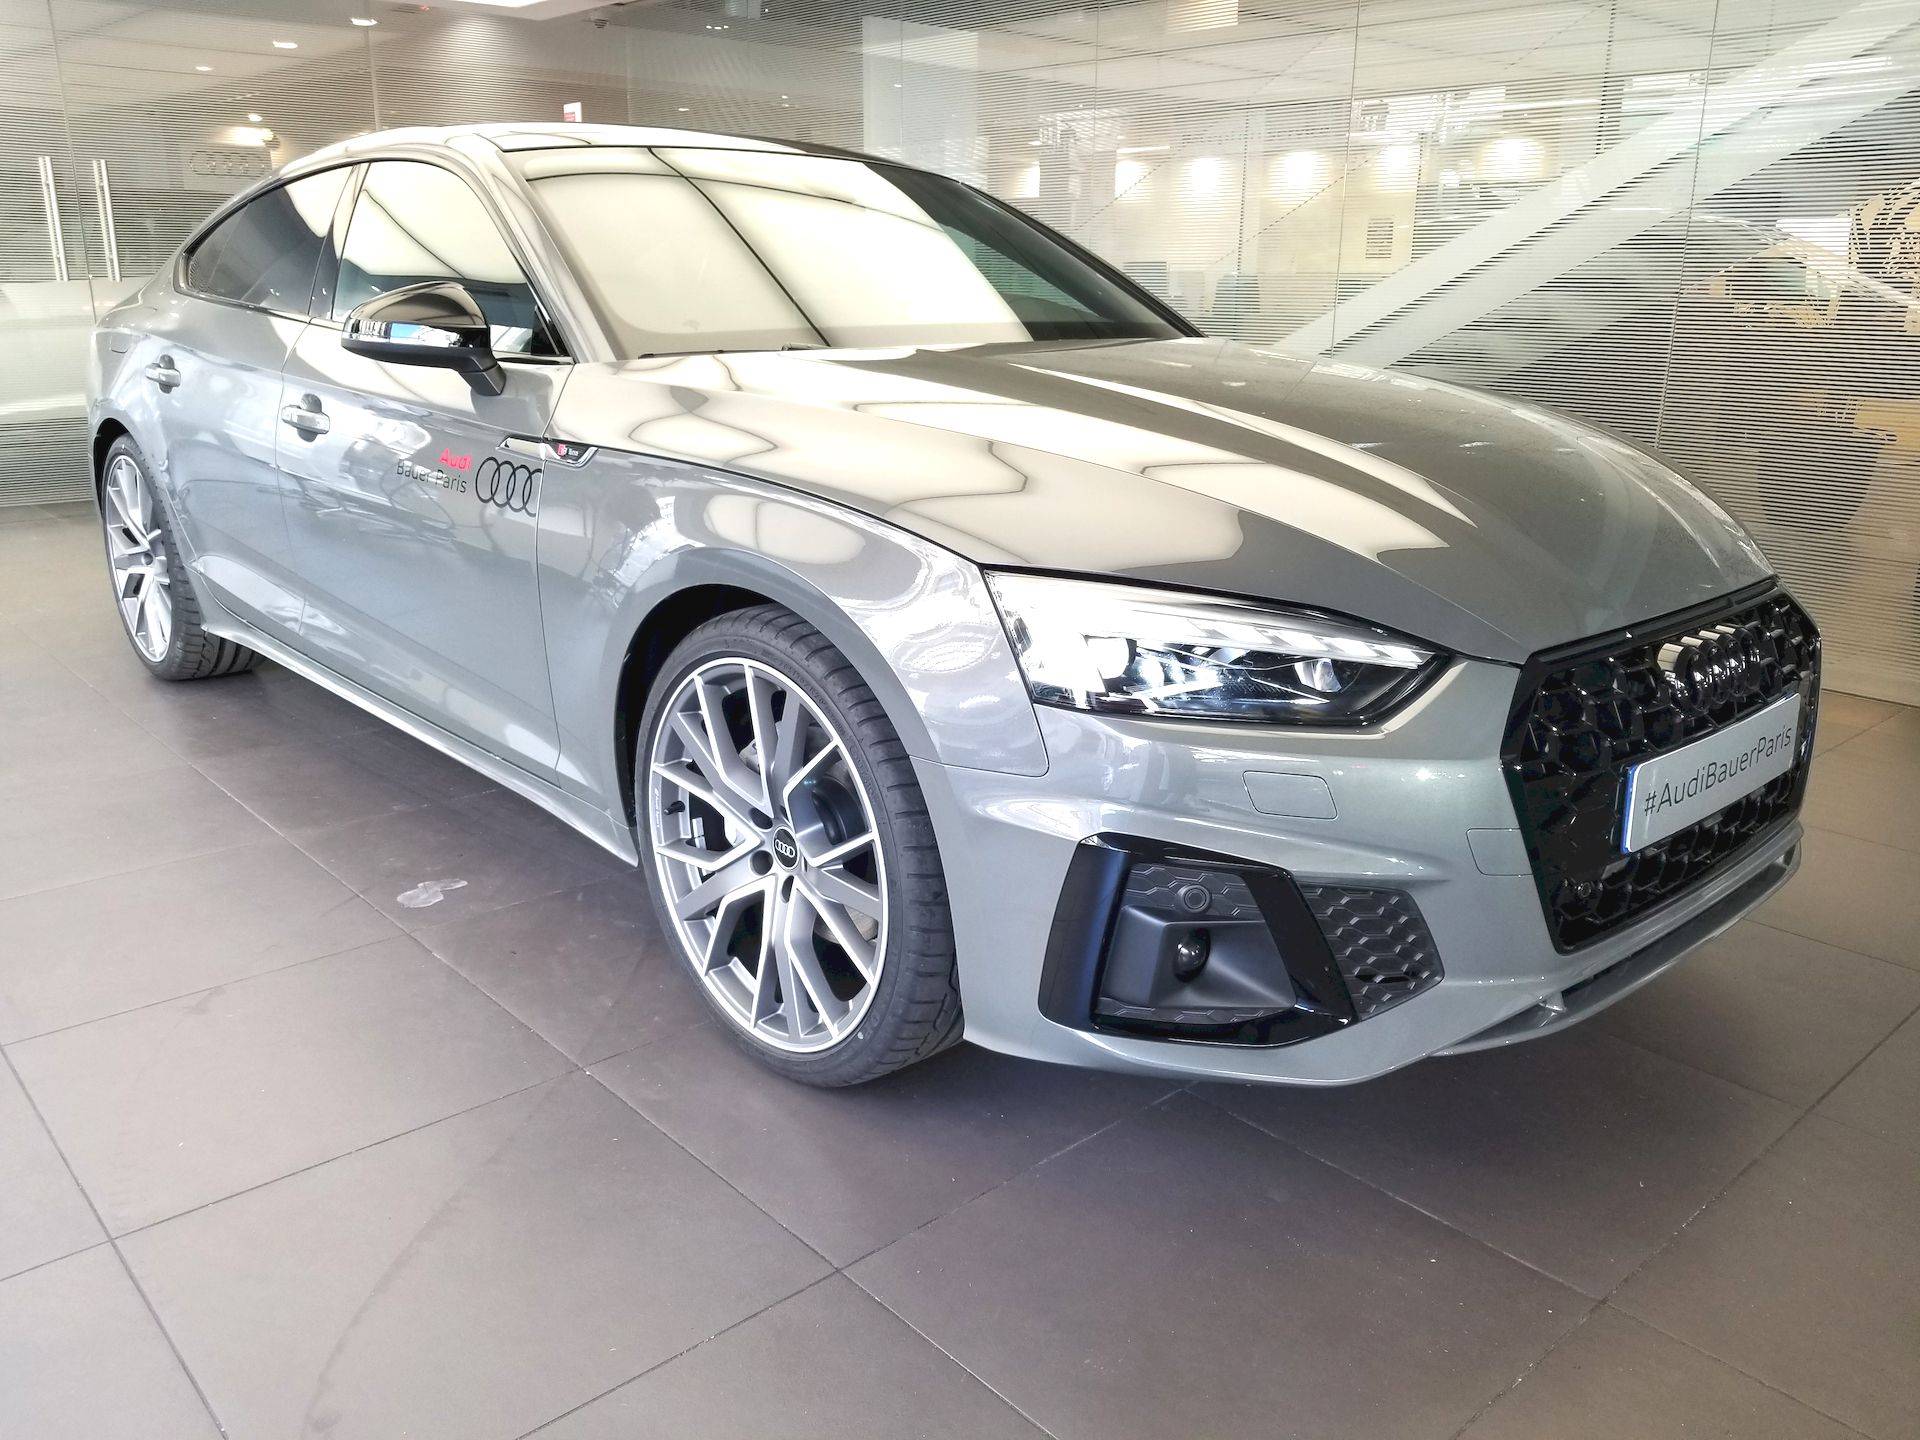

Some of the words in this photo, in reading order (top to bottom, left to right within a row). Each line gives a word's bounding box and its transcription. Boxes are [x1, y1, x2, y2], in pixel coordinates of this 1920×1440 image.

[397, 459, 429, 483] Bauer
[436, 469, 467, 493] Paris
[440, 447, 472, 471] Audi
[1644, 725, 1792, 817] #AudiBauerParis
